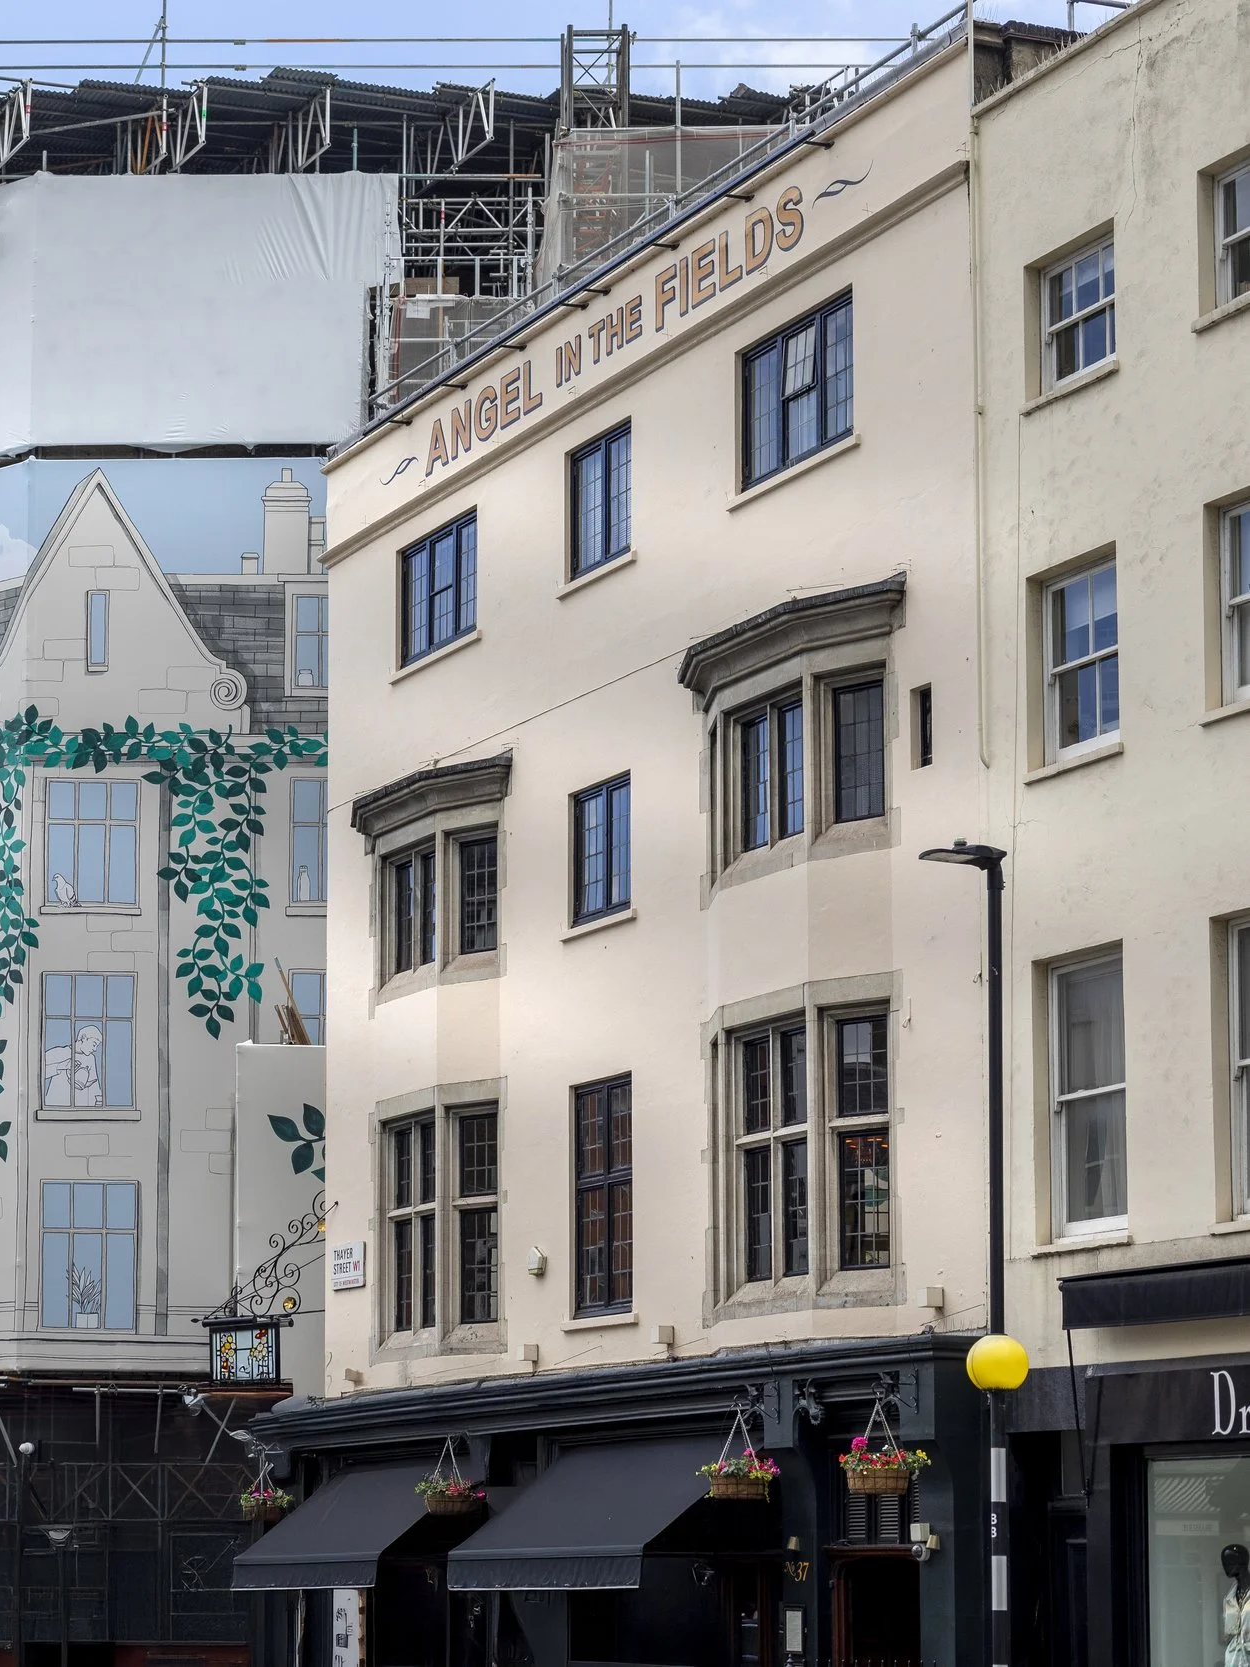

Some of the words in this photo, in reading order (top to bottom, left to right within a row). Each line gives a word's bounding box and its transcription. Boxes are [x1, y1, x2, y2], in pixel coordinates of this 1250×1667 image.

[425, 359, 543, 477] ANGEL
[555, 333, 582, 388] IN
[588, 294, 643, 365] THE
[654, 185, 804, 334] FIELDS
[333, 1248, 353, 1261] THAYER
[333, 1262, 351, 1275] STREET
[352, 1260, 360, 1272] W1
[795, 1561, 809, 1582] 37
